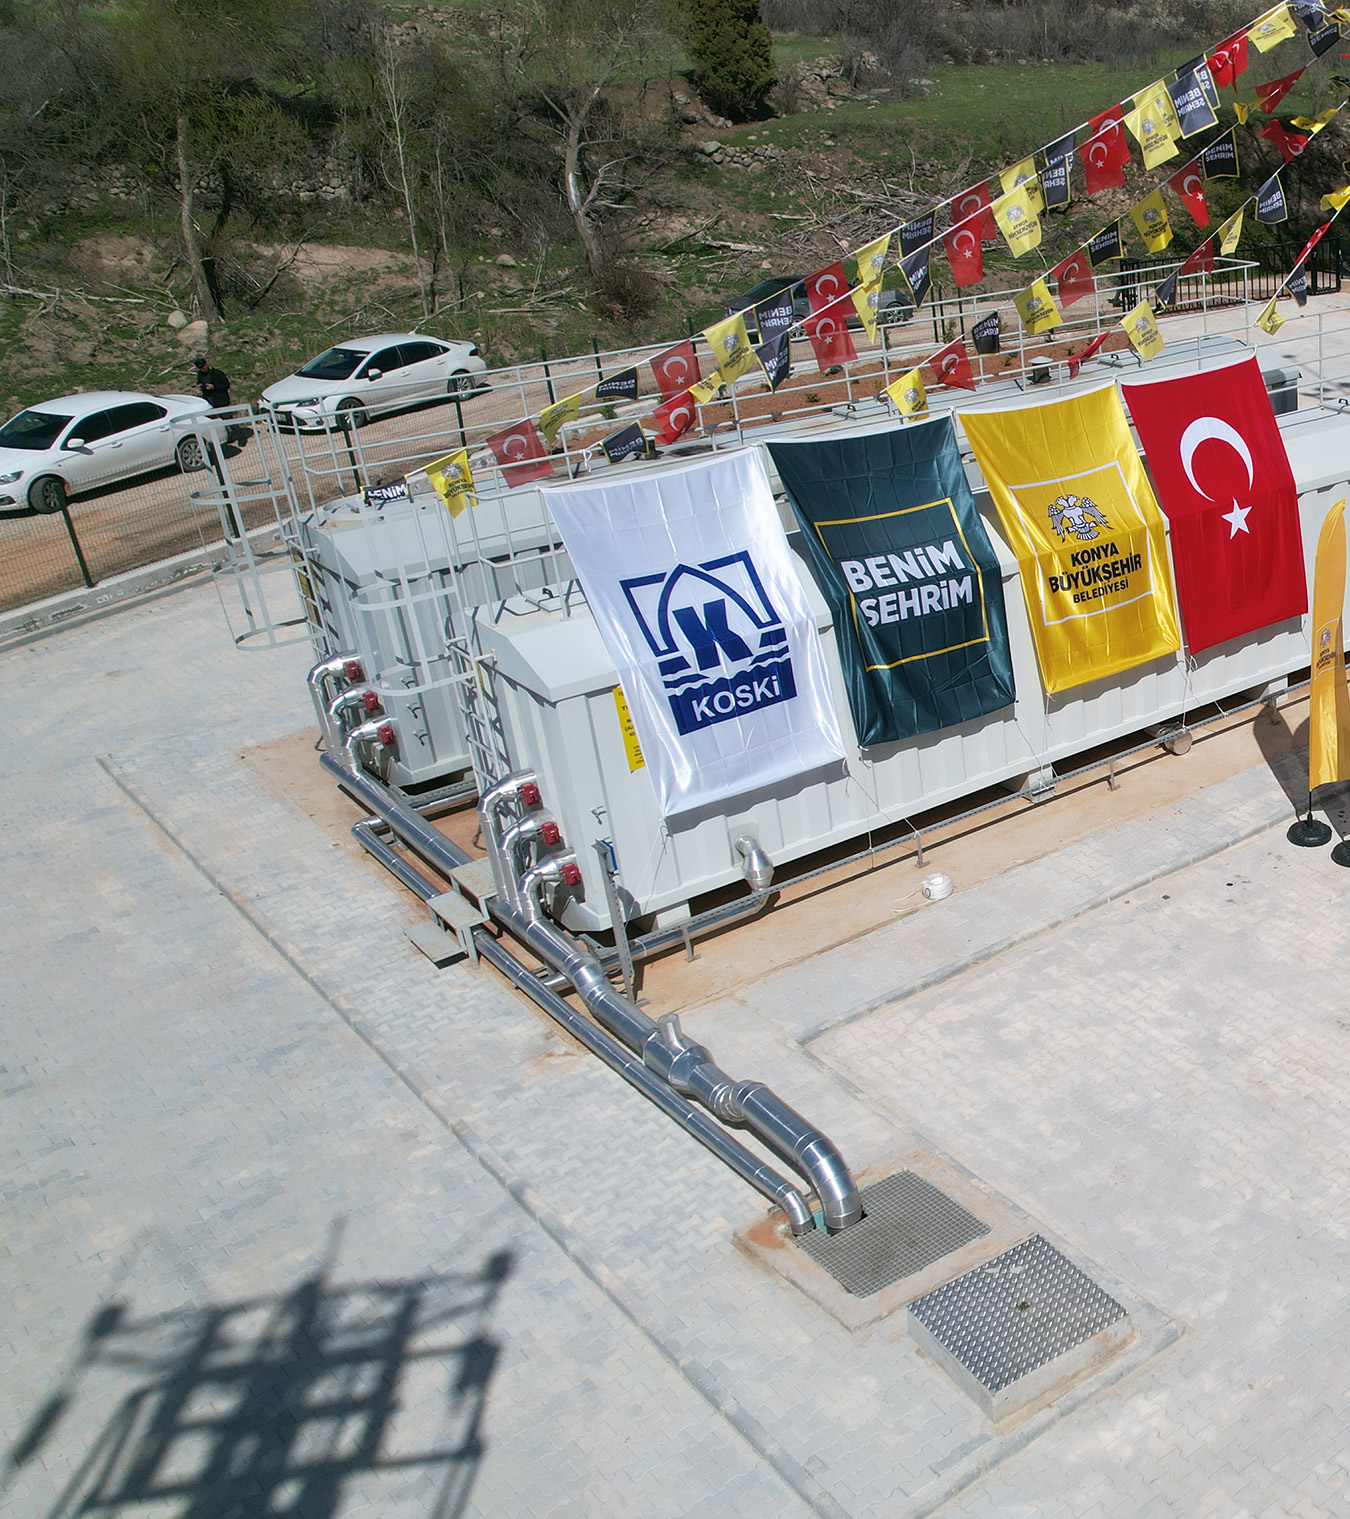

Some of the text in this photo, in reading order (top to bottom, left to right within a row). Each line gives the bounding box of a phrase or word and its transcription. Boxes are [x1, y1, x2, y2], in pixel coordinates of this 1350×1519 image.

[841, 540, 965, 593] BENİM
[1049, 553, 1142, 594] BÜYÜKŞEHİR
[1070, 542, 1119, 567] KONYA
[1073, 576, 1129, 603] BELEDİYESİ
[692, 676, 780, 722] KOSKİ
